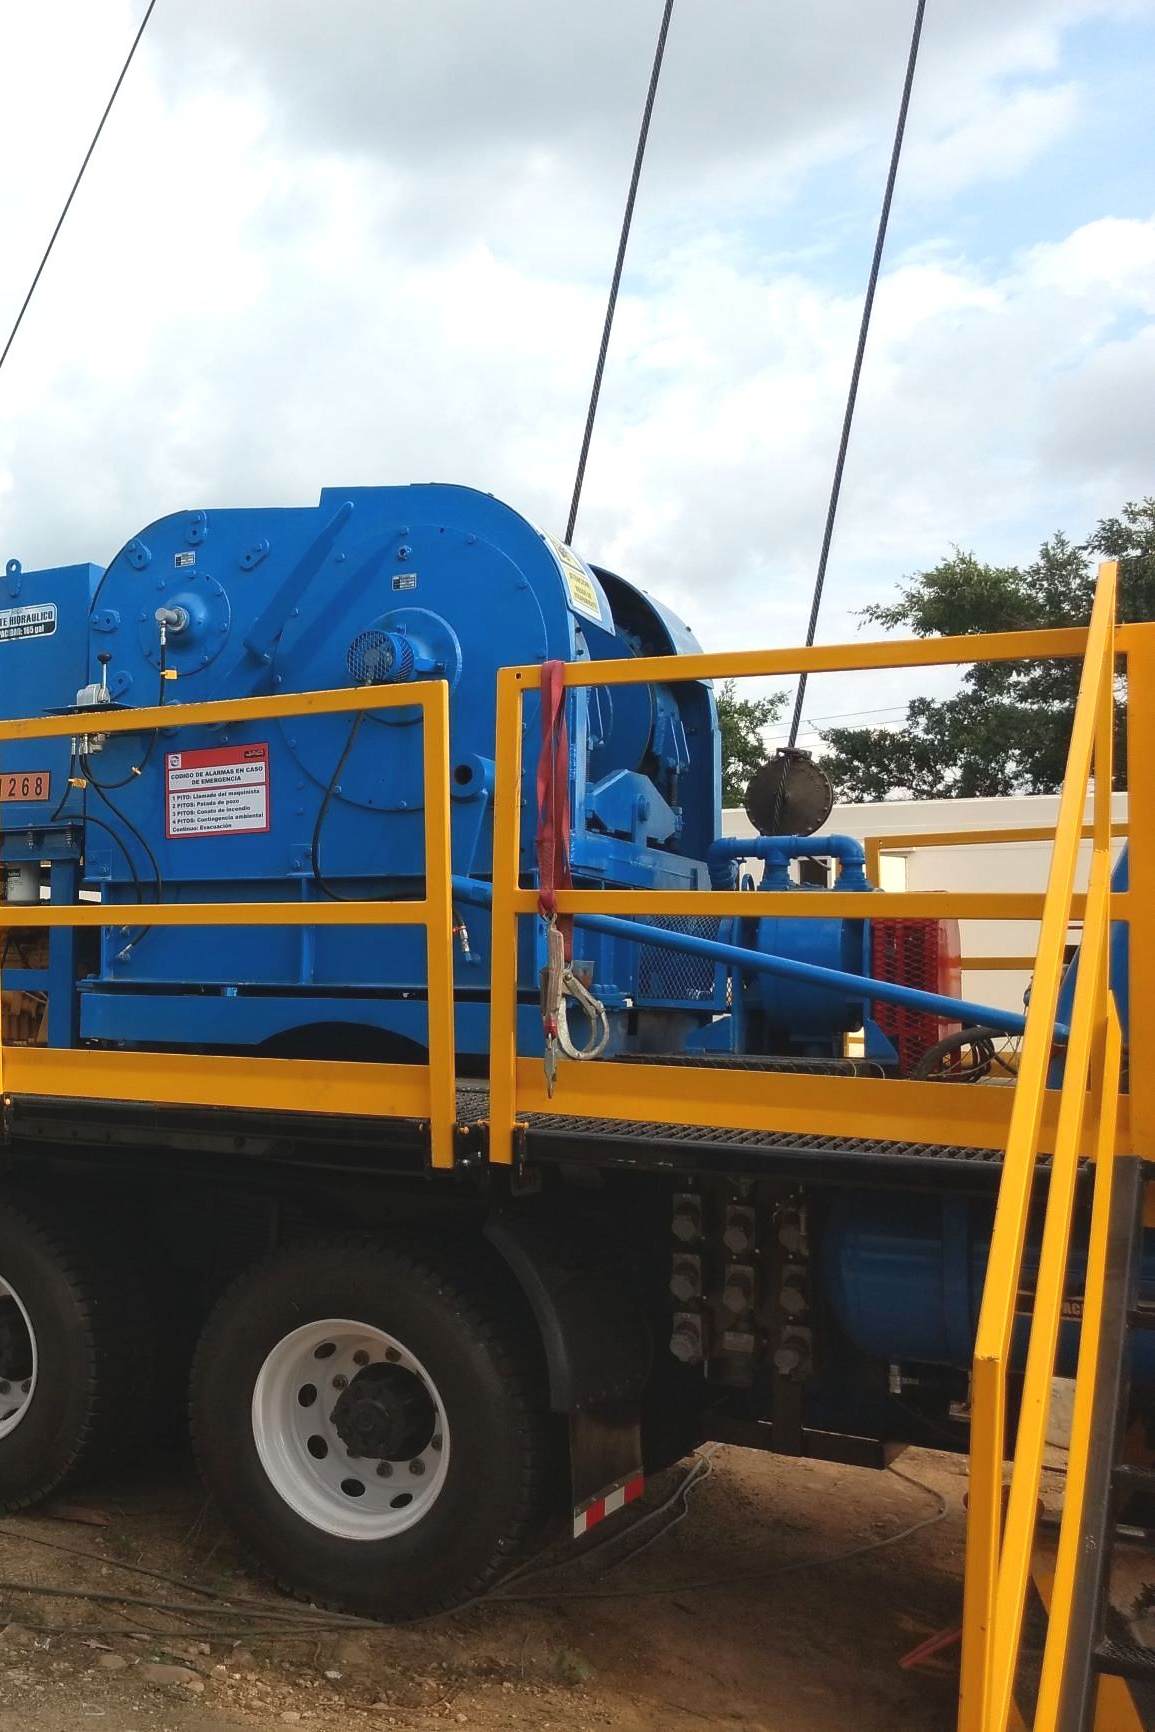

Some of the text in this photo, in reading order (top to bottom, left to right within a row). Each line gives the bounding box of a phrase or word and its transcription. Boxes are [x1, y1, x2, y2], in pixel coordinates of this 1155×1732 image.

[9, 611, 53, 625] HIDRAULICO
[35, 624, 45, 635] gal
[171, 772, 194, 780] CODIGO
[205, 768, 234, 777] ALARMAS
[246, 765, 263, 773] CASO
[201, 775, 241, 785] EMERGENCIA
[193, 791, 217, 800] Llamado
[228, 788, 260, 797] maquinista
[197, 815, 234, 823] Contingencia
[235, 812, 264, 820] ambiental
